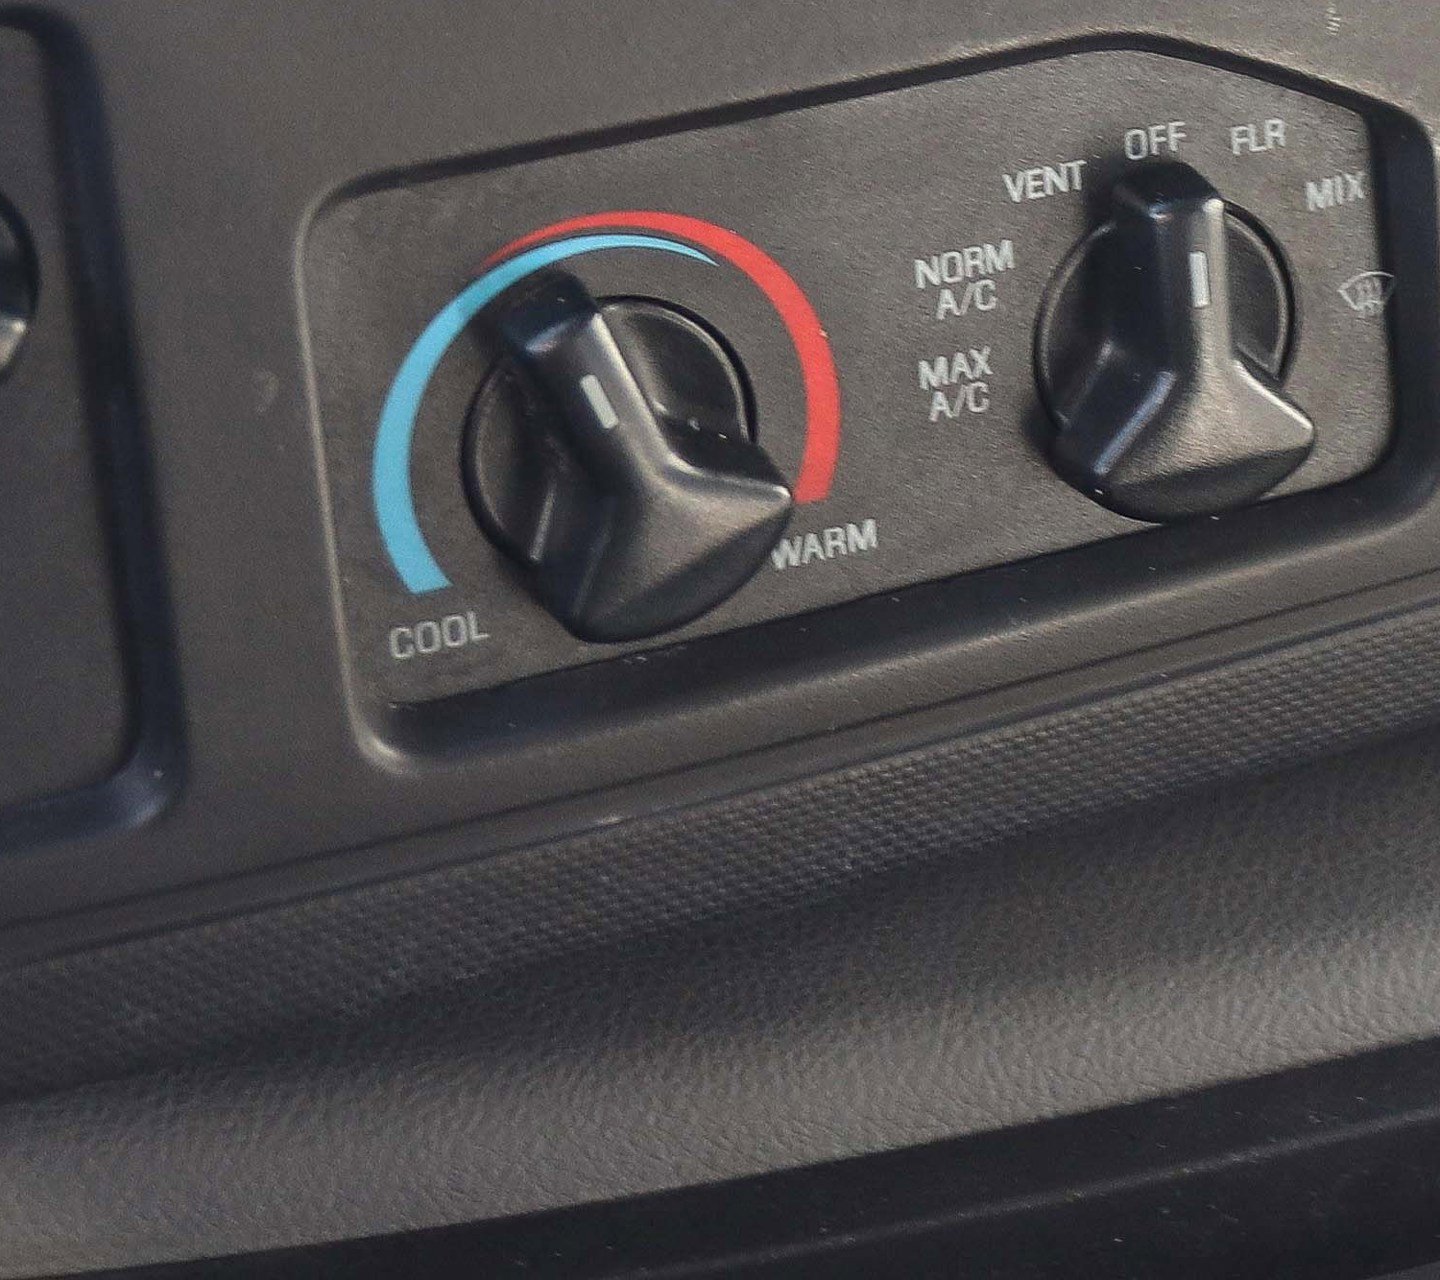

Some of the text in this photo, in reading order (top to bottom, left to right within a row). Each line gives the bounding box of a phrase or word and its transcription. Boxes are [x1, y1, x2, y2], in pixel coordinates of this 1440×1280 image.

[1126, 122, 1186, 159] OFF
[1232, 119, 1285, 154] FLR
[1003, 161, 1085, 202] VENT
[1307, 174, 1363, 210] MIX
[915, 240, 1014, 290] NORM
[934, 280, 997, 319] A/C
[919, 348, 992, 390] MAX
[929, 383, 988, 421] A/C
[772, 519, 877, 569] WARM
[390, 612, 489, 659] COOL
